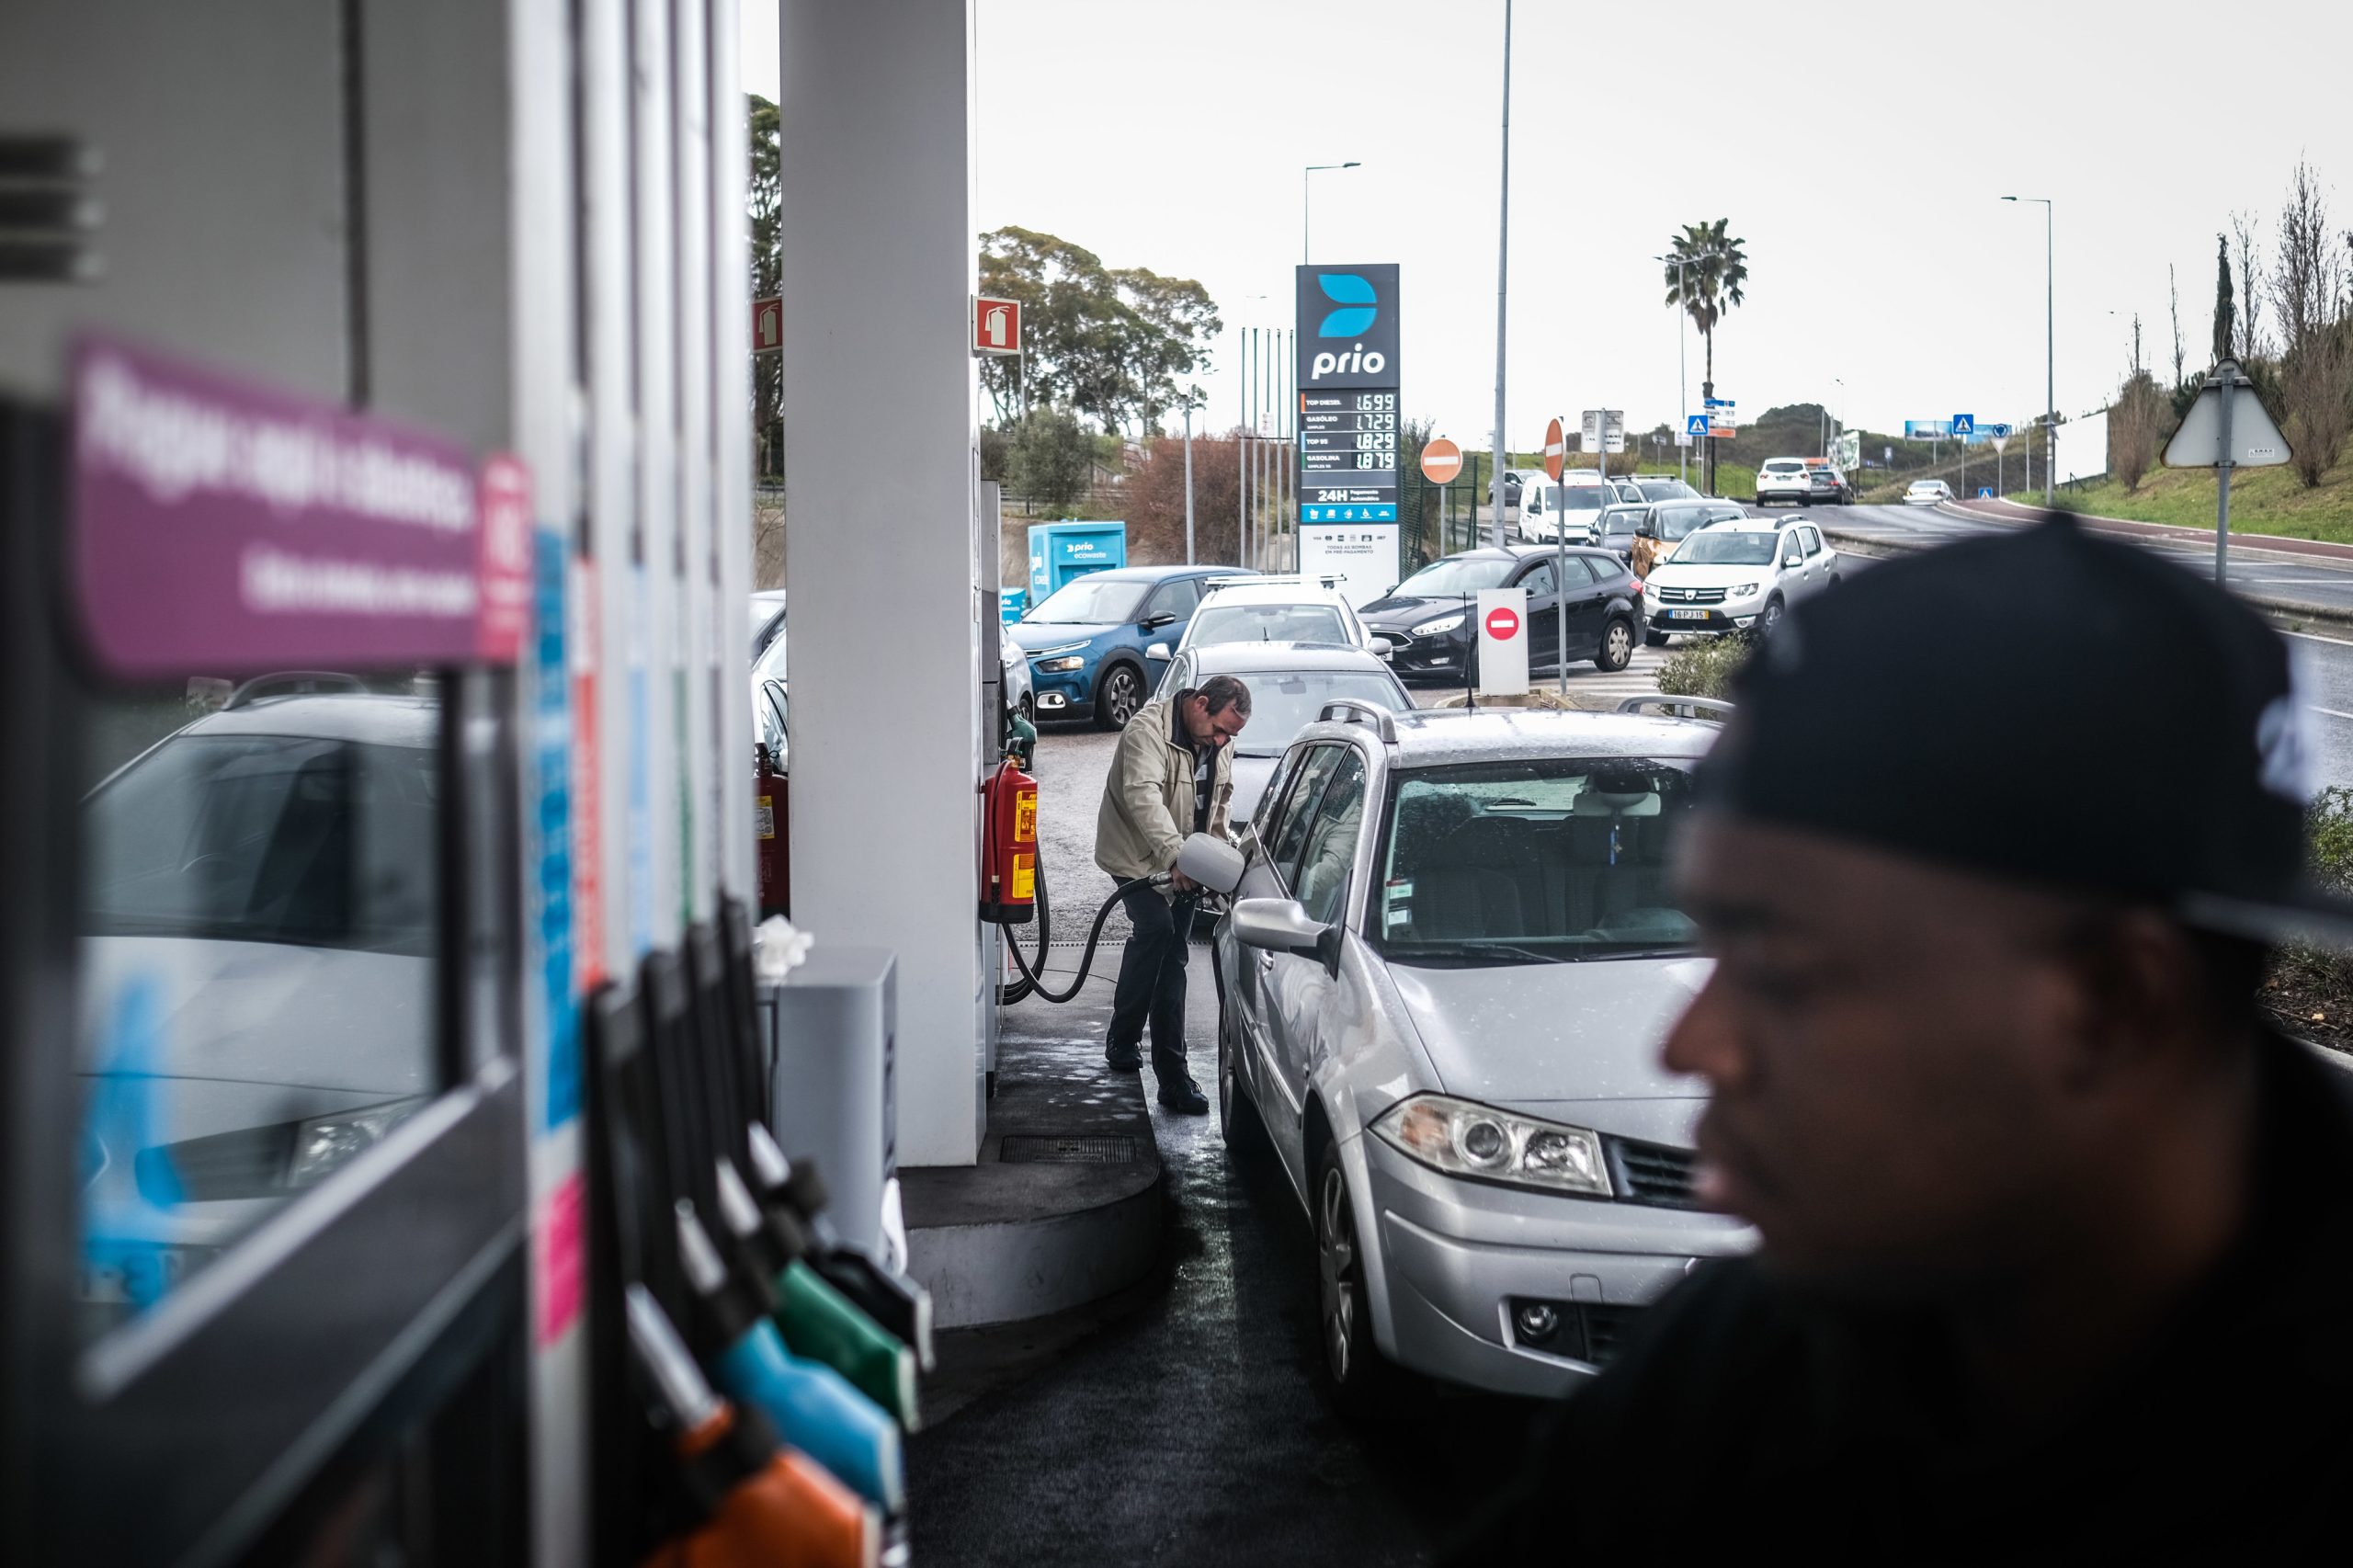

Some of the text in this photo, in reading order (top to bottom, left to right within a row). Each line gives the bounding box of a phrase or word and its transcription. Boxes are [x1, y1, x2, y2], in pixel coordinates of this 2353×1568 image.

[1312, 343, 1385, 380] prio
[1317, 489, 1348, 502] 24H
[1074, 542, 1094, 552] prio
[1002, 597, 1012, 606] rio
